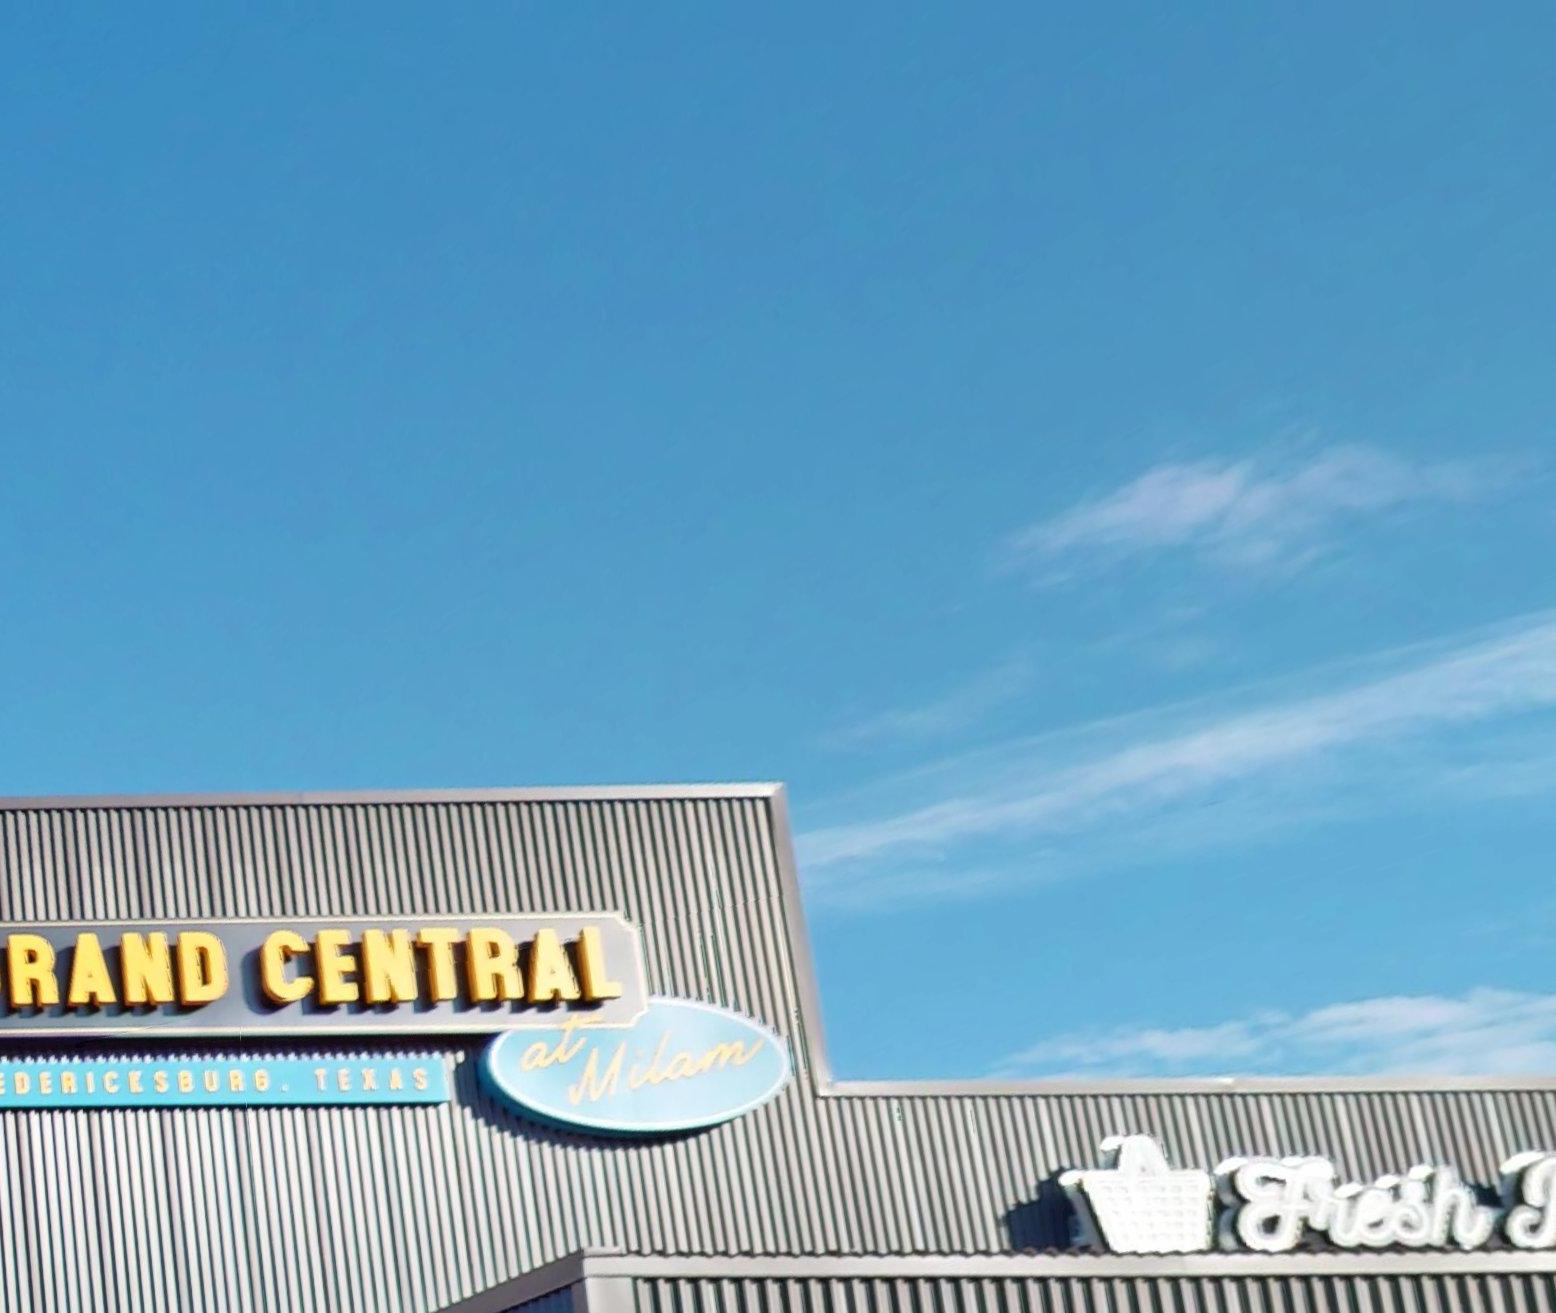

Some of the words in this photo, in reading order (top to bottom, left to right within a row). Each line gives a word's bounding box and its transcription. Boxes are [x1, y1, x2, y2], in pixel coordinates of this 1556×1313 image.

[259, 927, 623, 1005] CENTRAL
[314, 1066, 430, 1091] TEXAS
[520, 1014, 604, 1072] at
[569, 1030, 765, 1105] Milam
[1215, 1155, 1493, 1251] Fresh
